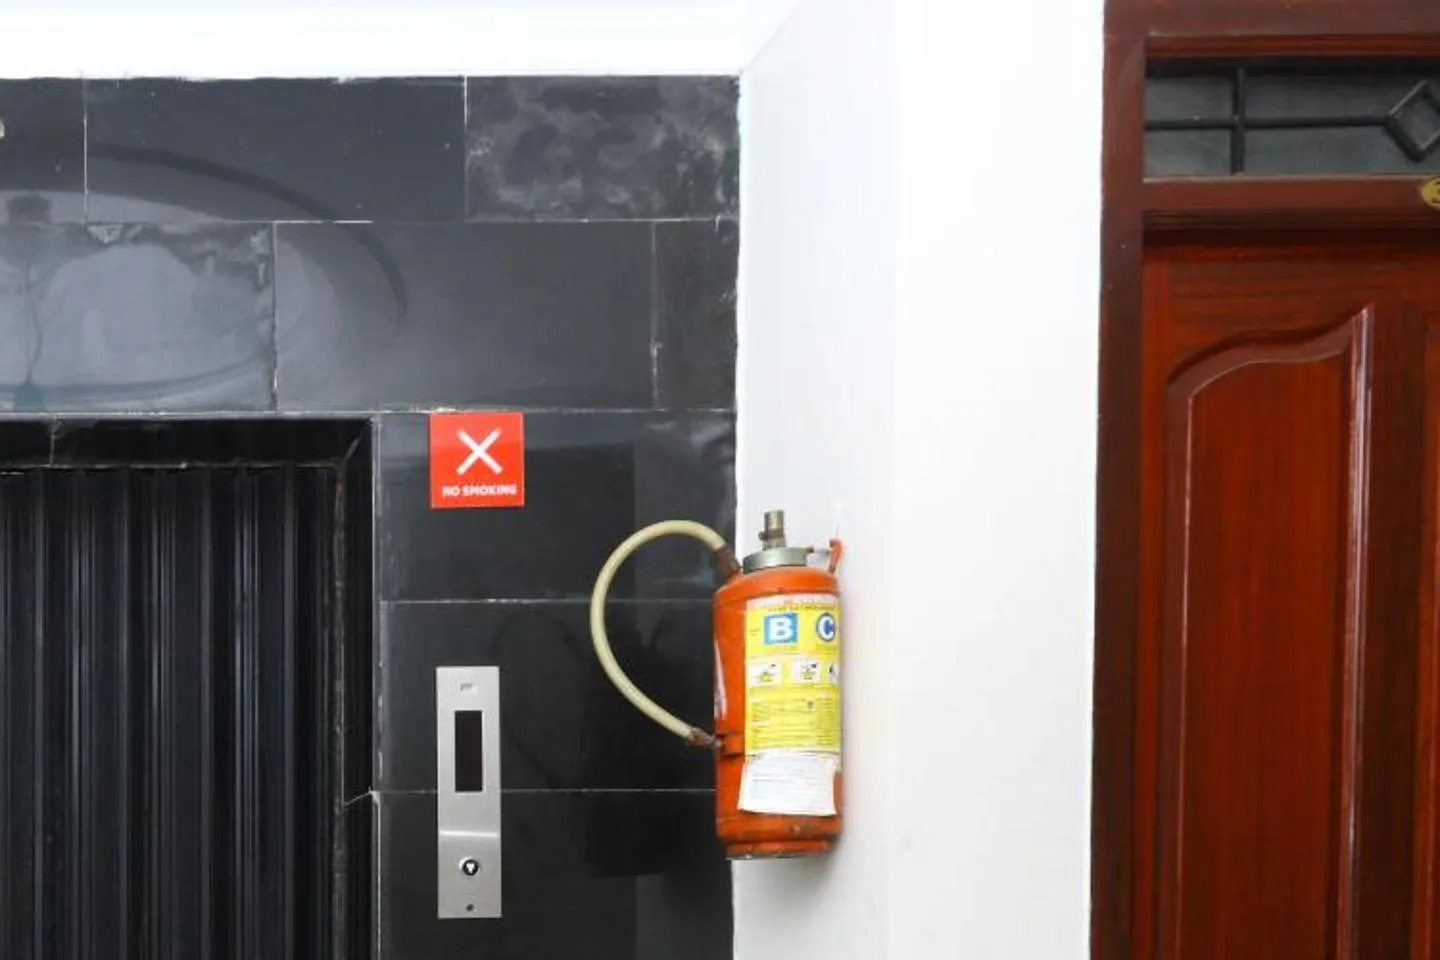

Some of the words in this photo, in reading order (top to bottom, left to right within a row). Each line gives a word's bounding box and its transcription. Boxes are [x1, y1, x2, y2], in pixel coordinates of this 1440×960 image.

[442, 485, 460, 497] NO
[462, 484, 517, 497] SMOKING
[769, 617, 794, 641] B
[818, 615, 835, 640] C
